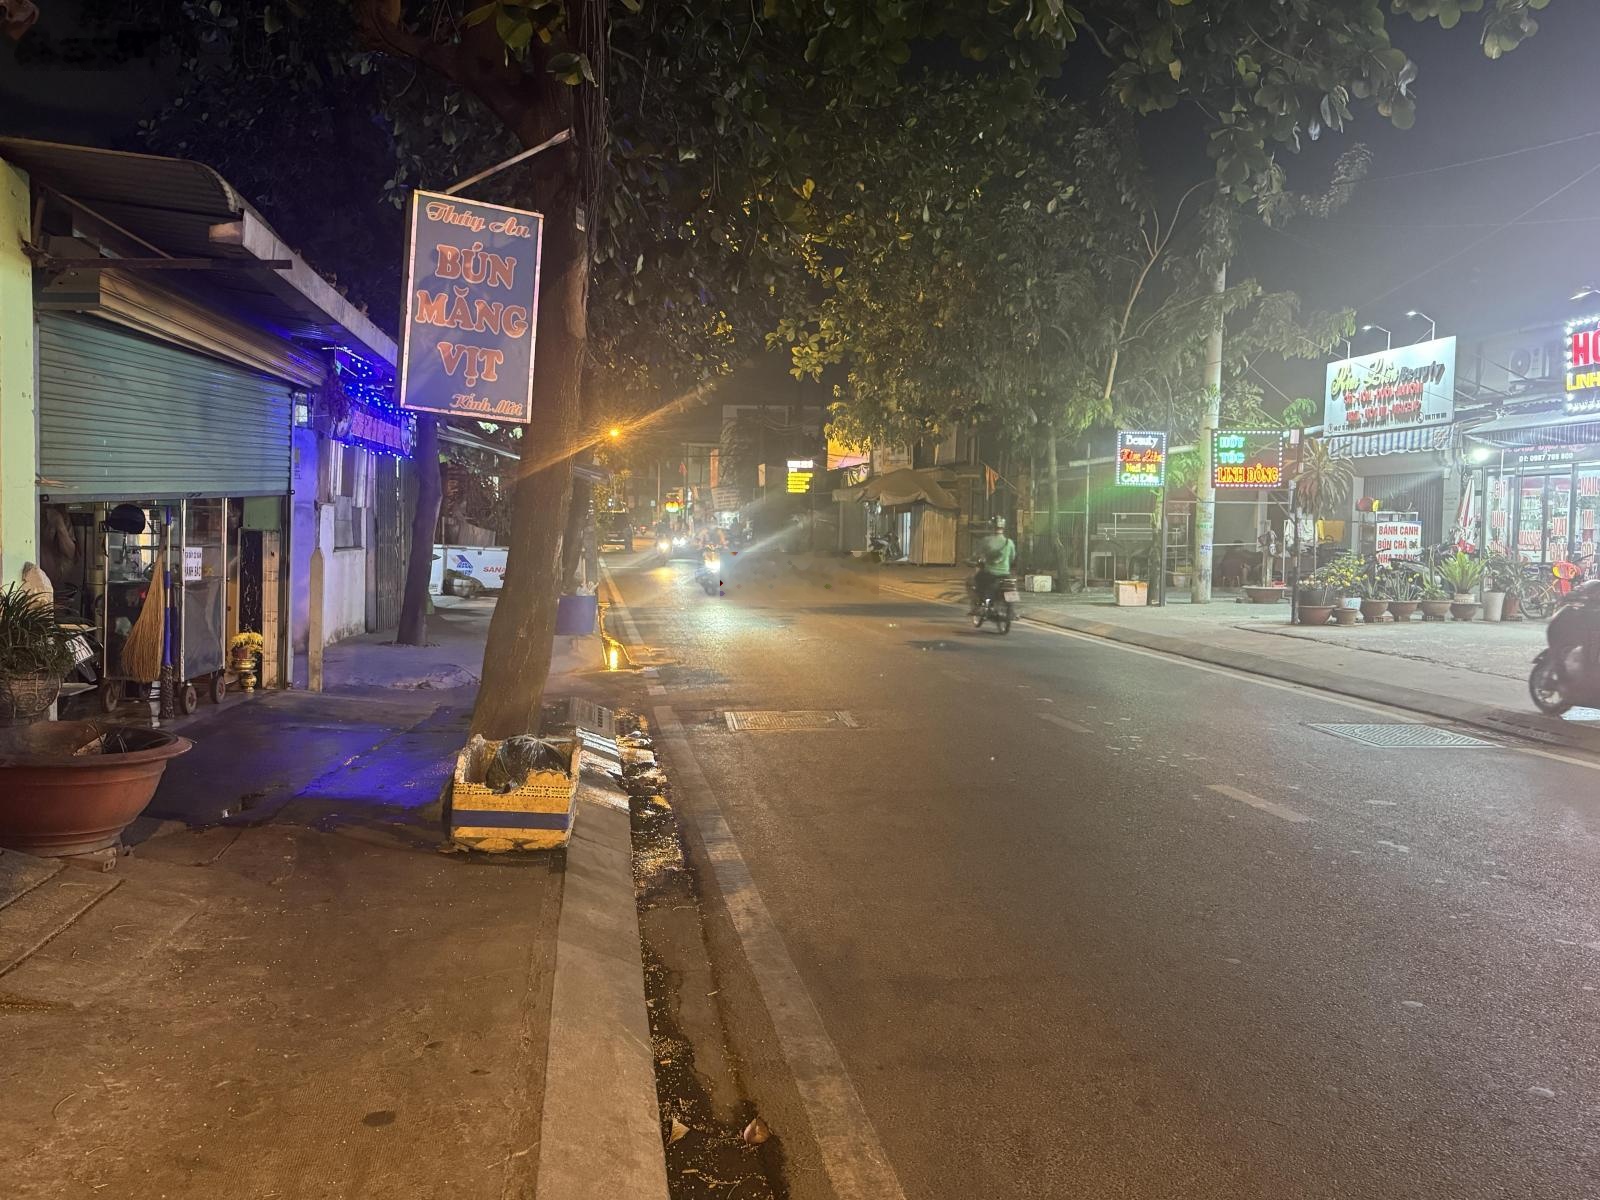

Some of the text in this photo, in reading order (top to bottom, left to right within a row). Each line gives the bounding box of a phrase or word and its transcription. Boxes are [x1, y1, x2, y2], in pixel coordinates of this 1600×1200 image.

[489, 217, 530, 238] An
[435, 242, 517, 290] BÚN
[415, 286, 528, 338] MĂNG
[437, 342, 504, 387] VỊT
[1218, 450, 1246, 464] TÓC
[1217, 462, 1280, 483] LINH ĐÔNG
[1378, 524, 1419, 536] BÁNH CANH
[1378, 538, 1392, 549] BÚN
